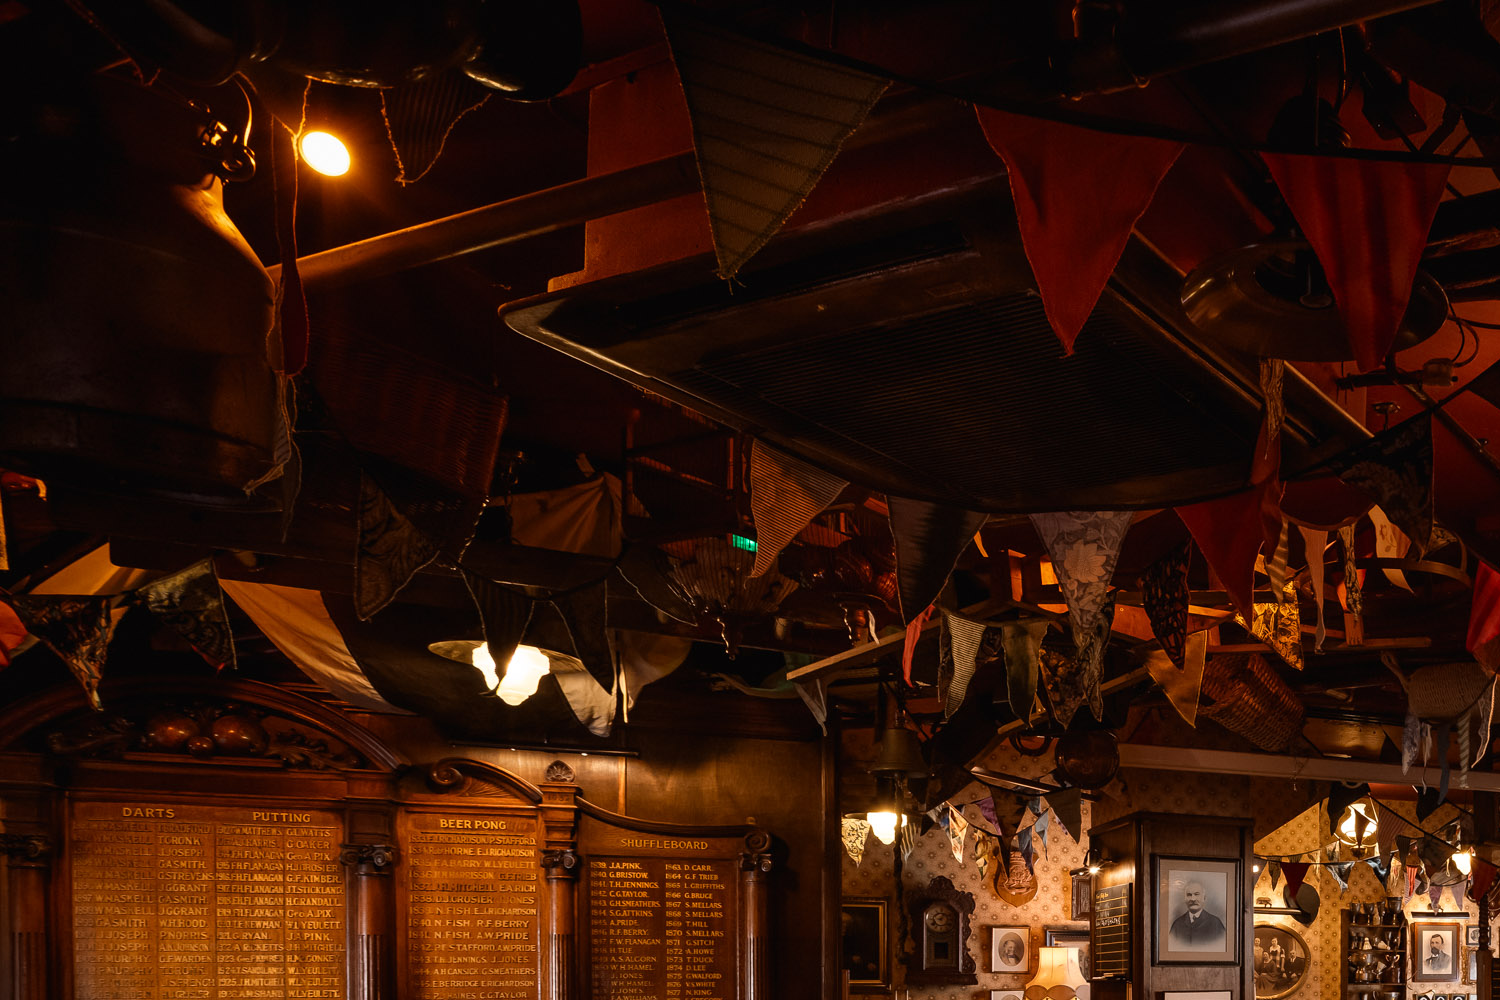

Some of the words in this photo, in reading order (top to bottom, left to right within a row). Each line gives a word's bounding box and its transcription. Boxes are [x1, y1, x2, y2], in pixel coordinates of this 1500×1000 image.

[122, 807, 175, 818] DARTS
[252, 812, 311, 822] PUTTING
[440, 819, 472, 828] BEER
[475, 820, 506, 829] PONG
[621, 839, 708, 850] SHUFFLEBOARD
